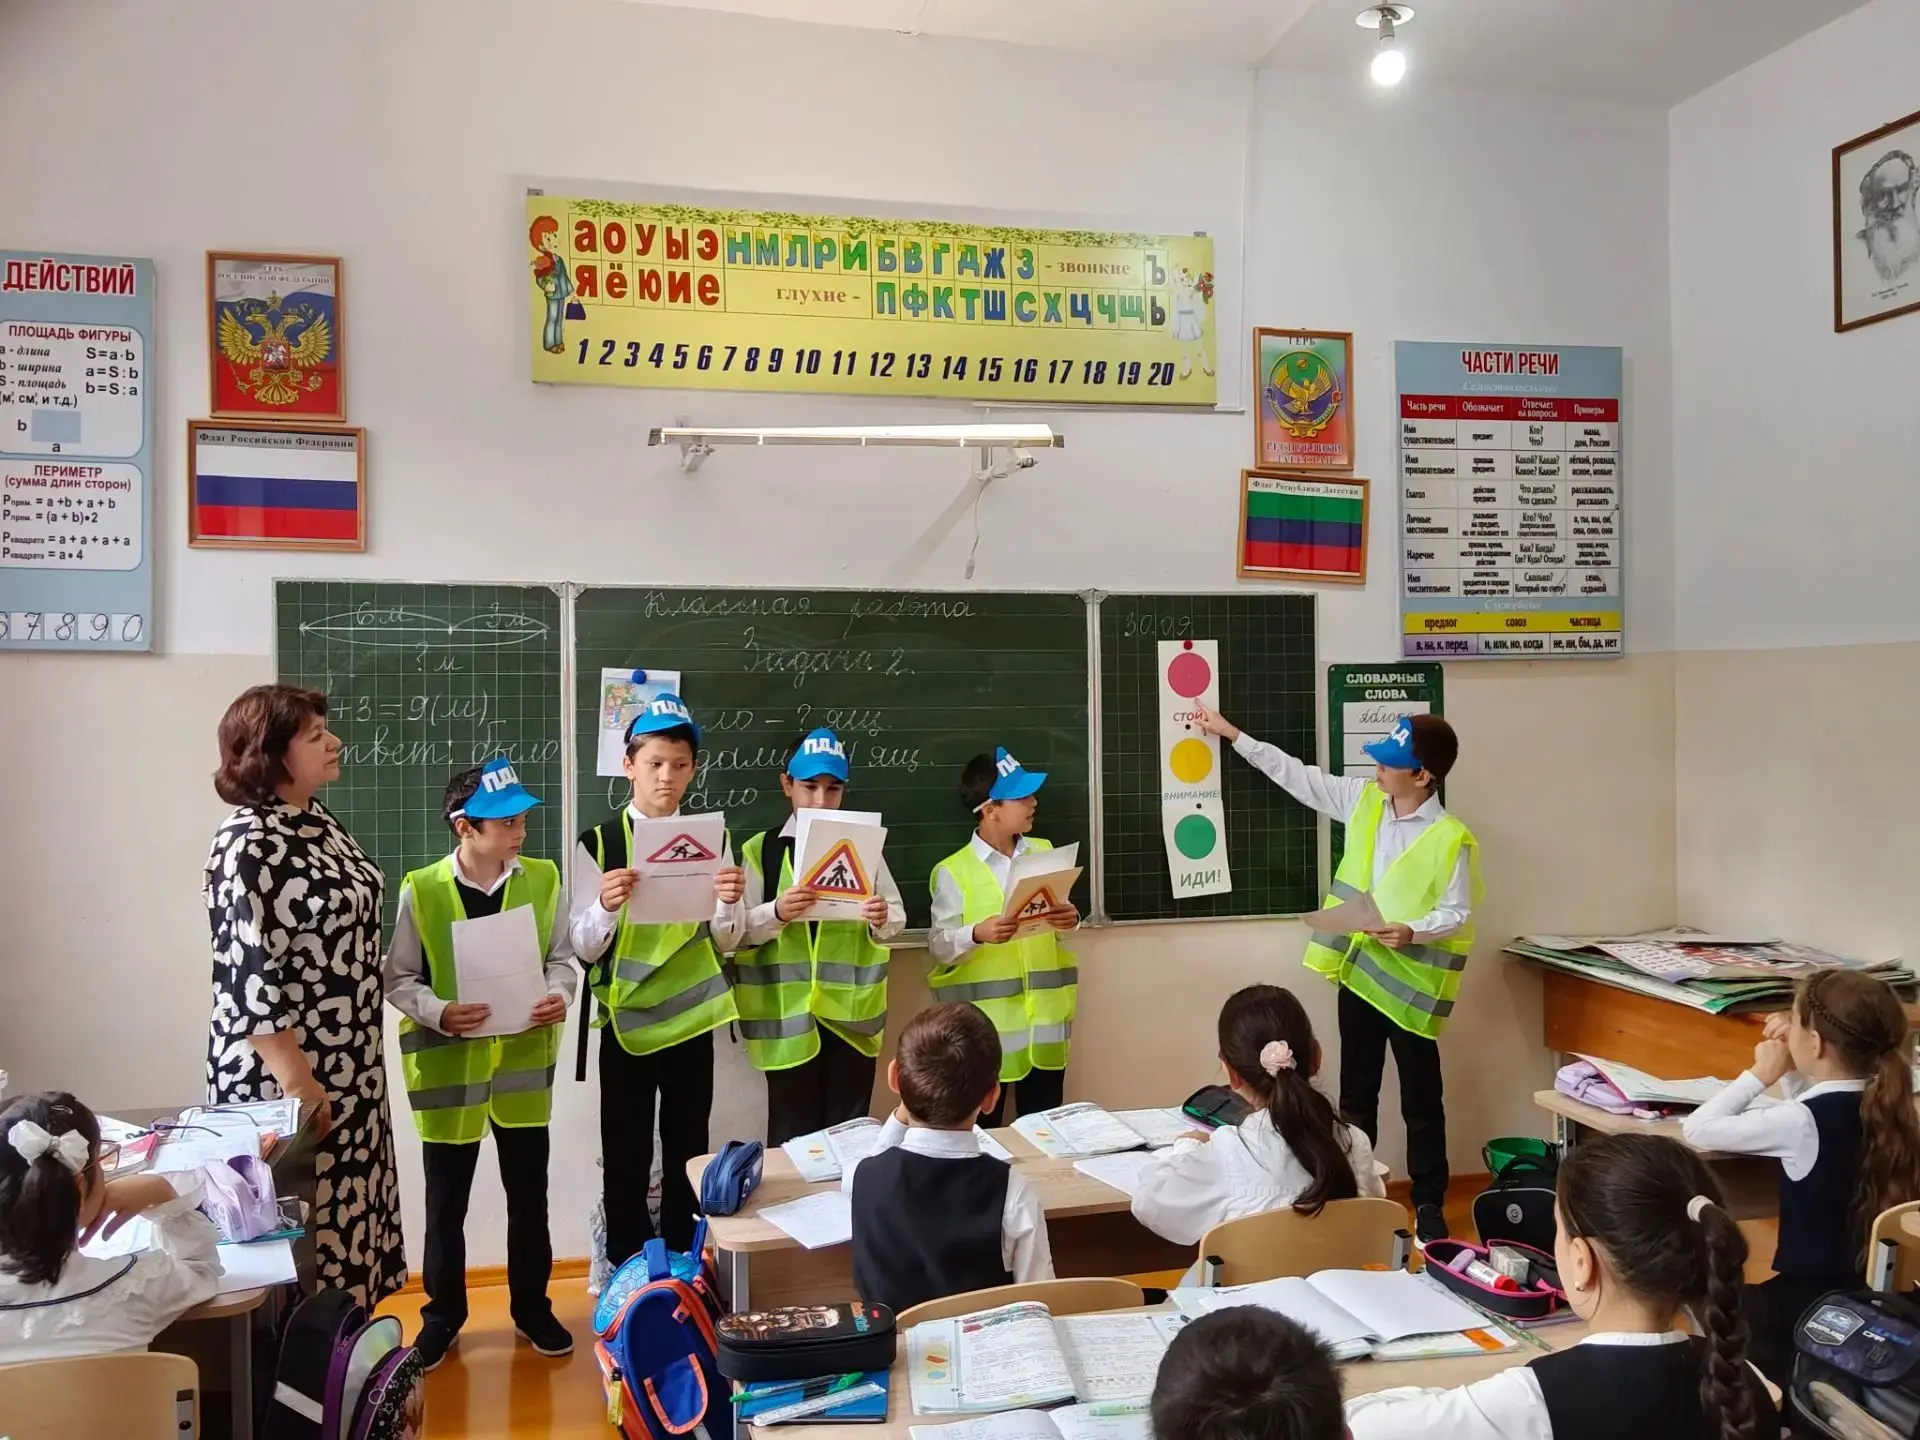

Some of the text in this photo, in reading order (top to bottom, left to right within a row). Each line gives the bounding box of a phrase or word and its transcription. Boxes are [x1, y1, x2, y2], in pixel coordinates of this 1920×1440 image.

[1057, 261, 1131, 275] звонкие
[3, 259, 135, 295] ДЕЙСТВИЙ
[776, 287, 847, 305] глухие
[9, 325, 131, 342] ПЛОЩАДЬ ФИГУРЫ
[17, 345, 51, 357] длина
[578, 338, 1175, 386] 1 2 3 4 5 6 7 8 9 10 11 12 13 14 15 16 17 18 19 20
[1462, 351, 1559, 375] ЧАСТИ РЕЧИ
[17, 363, 62, 375] ширина
[17, 379, 66, 390] площадь
[1407, 400, 1447, 413] Часть речи
[1462, 401, 1504, 412] Обозначает
[1521, 398, 1554, 409] Отвечает
[1527, 410, 1558, 420] вопросы
[1529, 425, 1544, 435] Кто?
[199, 433, 354, 449] Флаг Российской Федерации
[1528, 436, 1544, 446] Что?
[34, 465, 103, 478] ПЕРИМЕТР
[5, 474, 131, 493] (сумма длин сторон)
[645, 591, 815, 617] Классная
[25, 612, 42, 641] 7
[55, 613, 76, 641] 8
[89, 614, 109, 641] 9
[1424, 618, 1458, 632] предлог
[1505, 617, 1527, 627] союз
[1569, 617, 1602, 628] частица
[1445, 640, 1469, 653] перед
[1523, 639, 1544, 650] когда
[1604, 638, 1618, 648] нет
[1345, 673, 1426, 684] СЛОВАРНЫЕ
[1364, 689, 1408, 700] СЛОВА
[803, 737, 846, 760] ПДД
[1163, 789, 1221, 801] ВНИМАНИЕ!
[1180, 868, 1222, 889] ИДИ!
